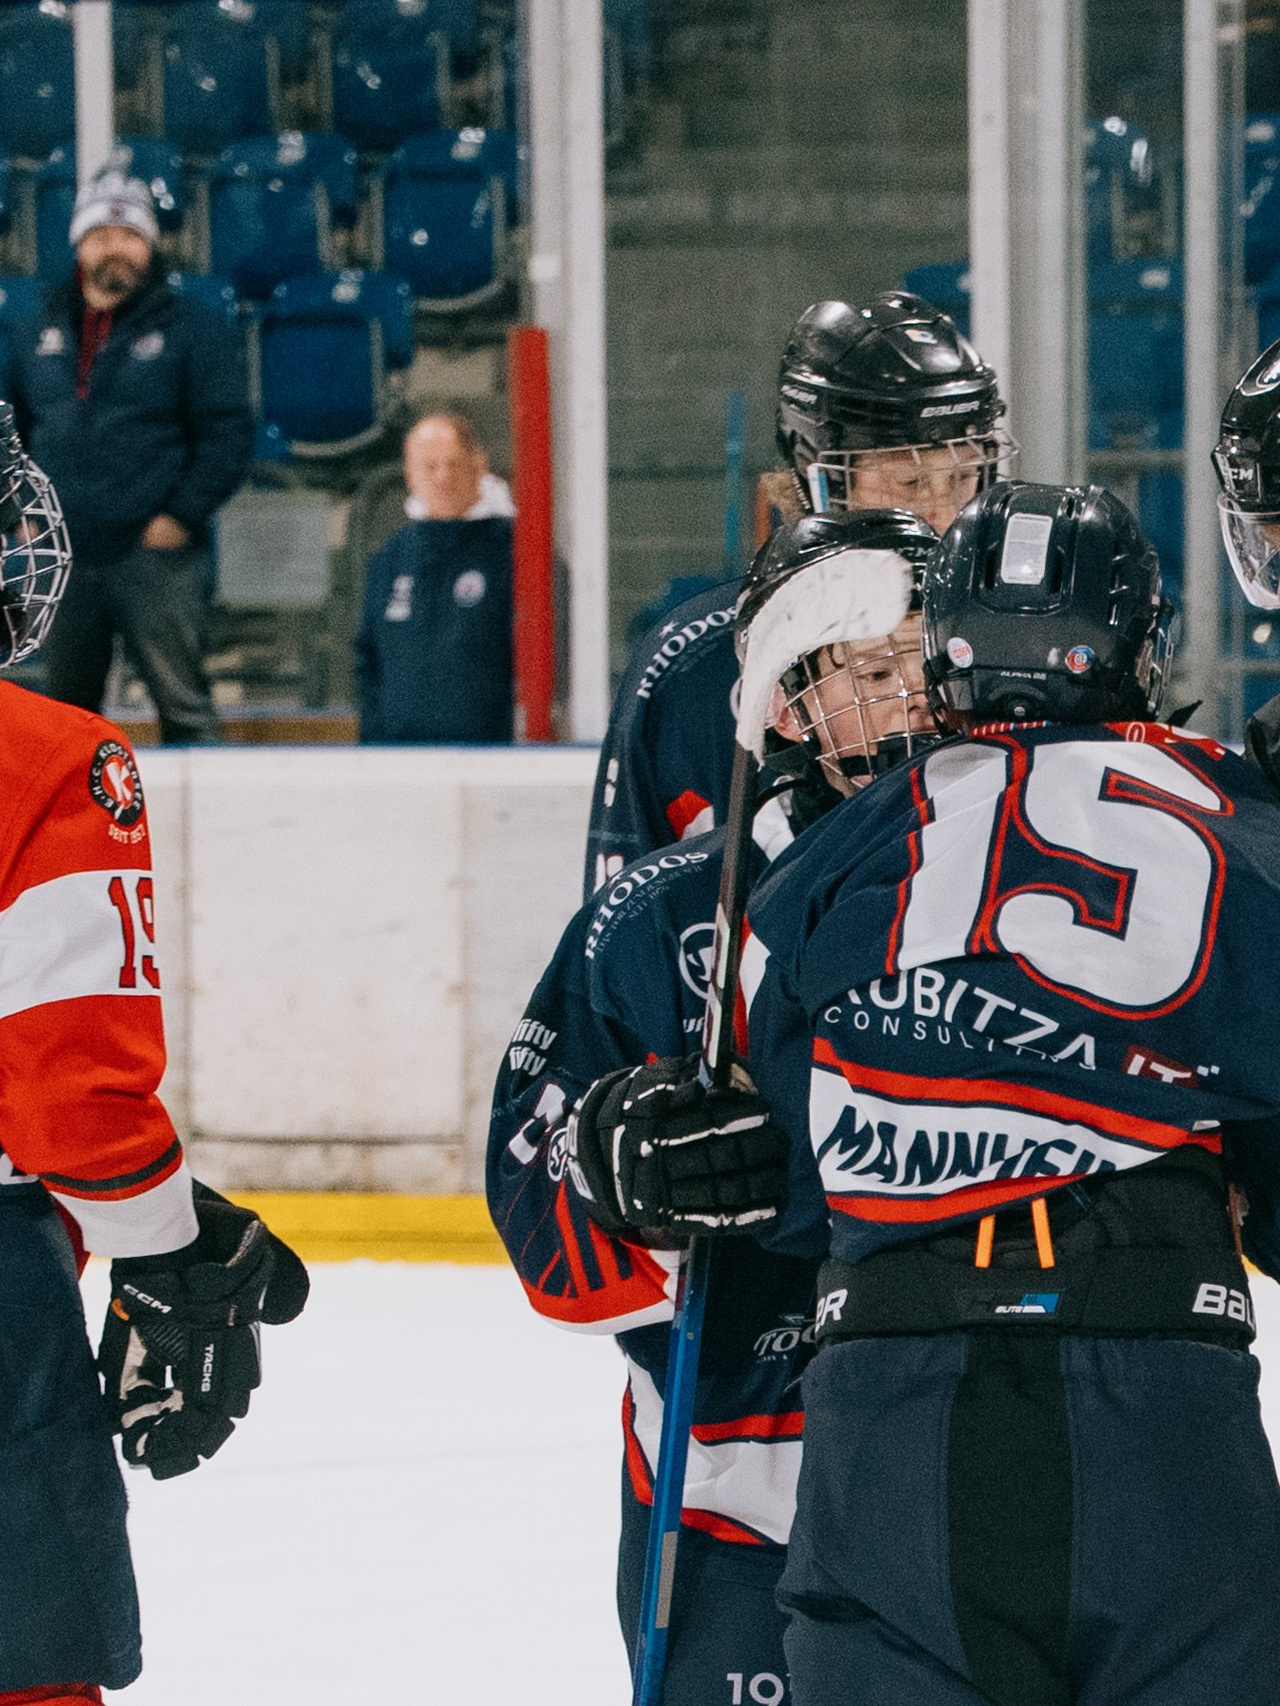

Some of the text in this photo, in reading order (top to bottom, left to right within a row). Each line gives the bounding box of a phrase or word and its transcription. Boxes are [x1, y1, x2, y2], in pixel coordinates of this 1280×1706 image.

[893, 738, 1230, 1015] 15
[584, 852, 708, 960] RHODOS
[512, 1018, 557, 1050] fifty
[509, 1046, 547, 1076] fifty
[123, 1284, 173, 1314] CCM
[200, 1343, 215, 1393] TACKS
[726, 1672, 791, 1706] 19
